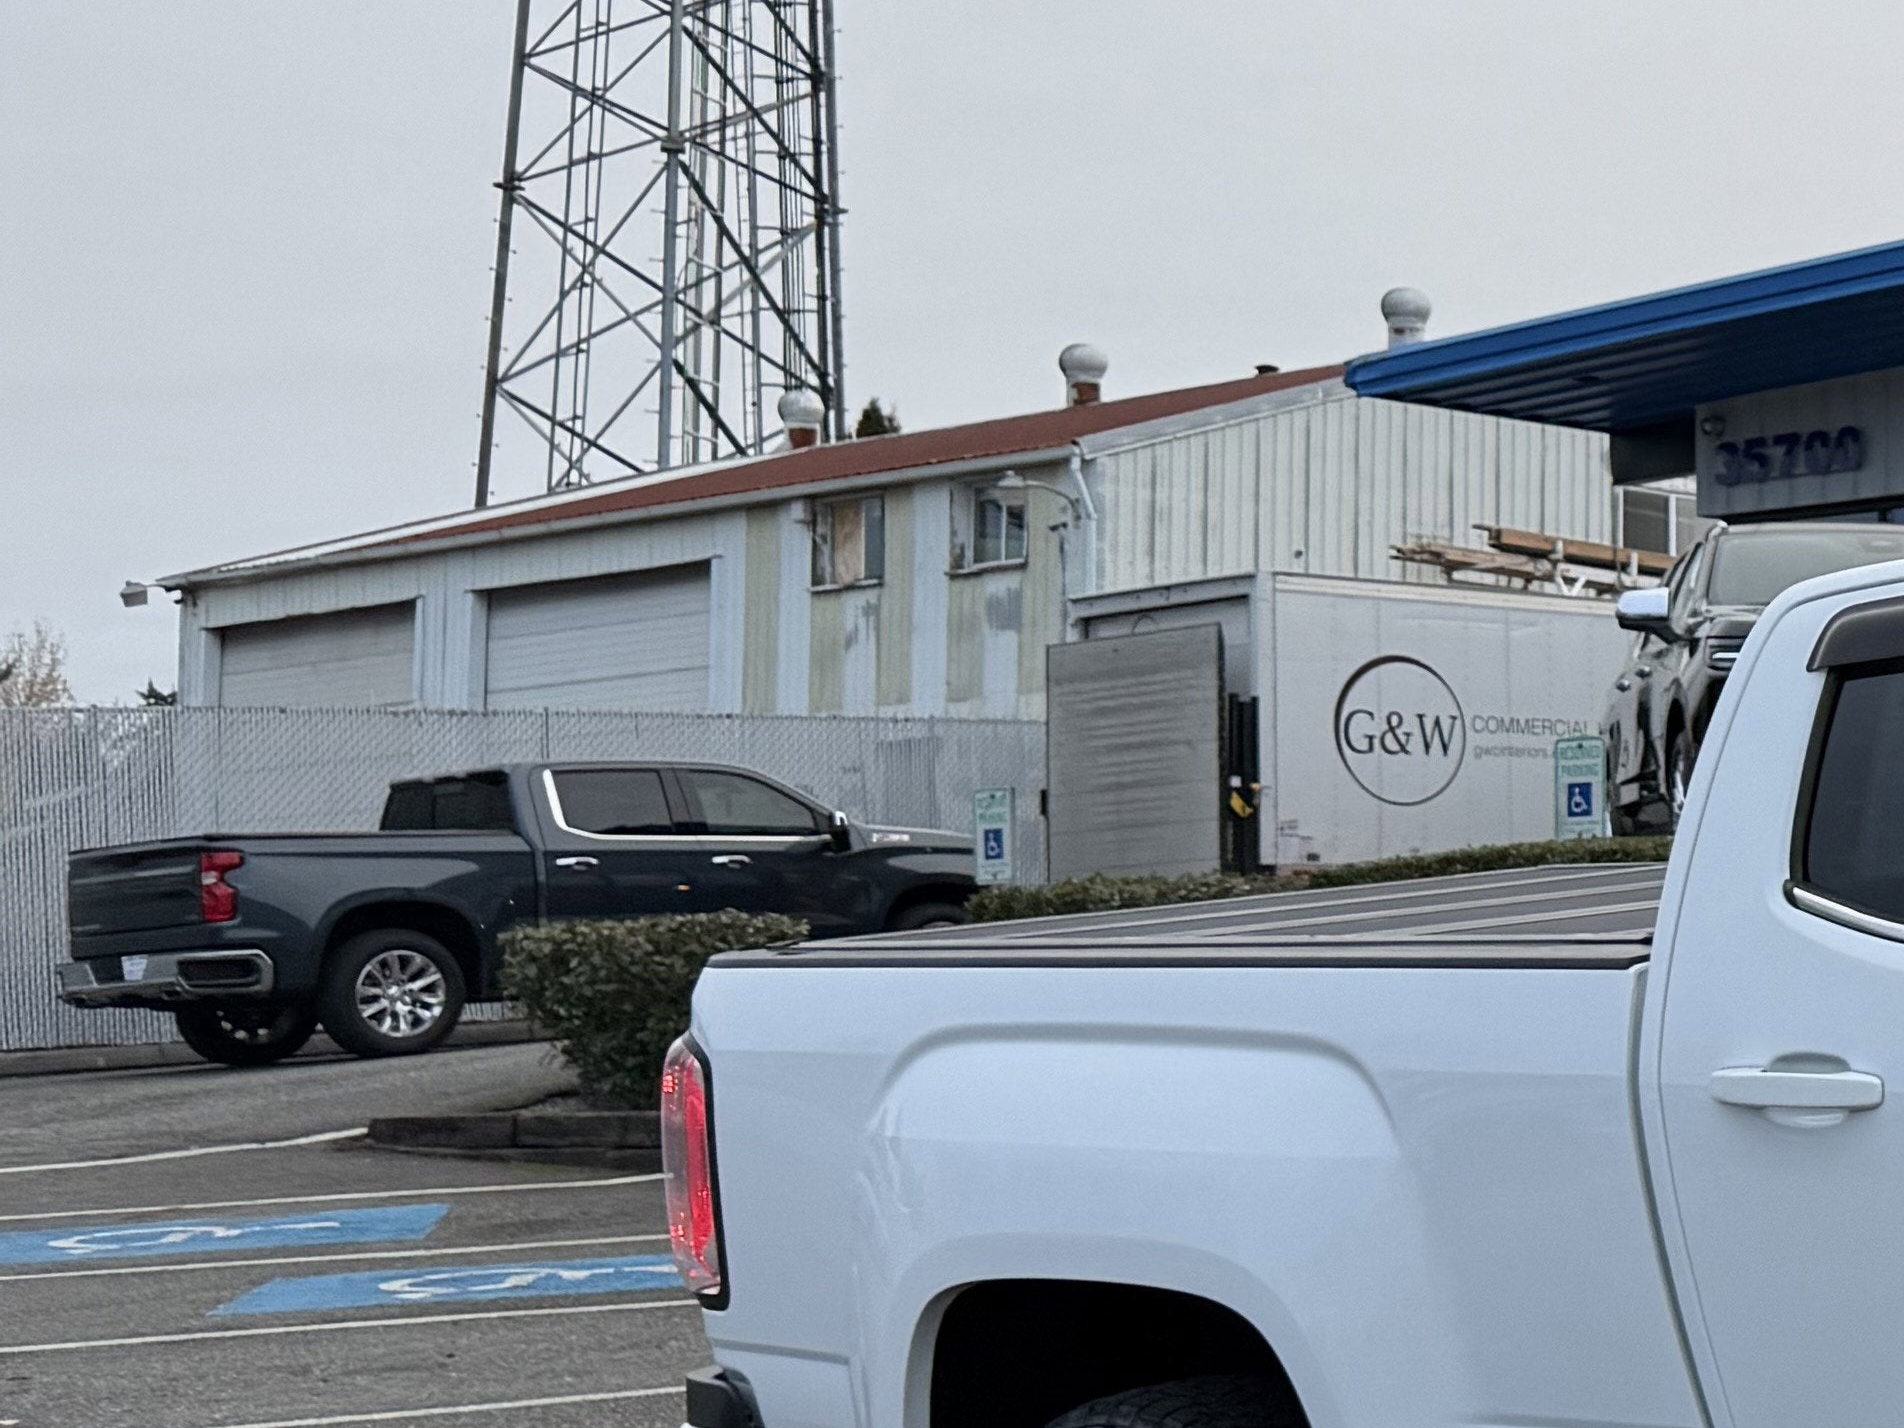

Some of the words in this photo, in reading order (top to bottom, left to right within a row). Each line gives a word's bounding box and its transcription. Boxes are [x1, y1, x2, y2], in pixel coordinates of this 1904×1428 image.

[1715, 426, 1866, 487] 35700
[1343, 708, 1458, 758] G&W
[1472, 714, 1588, 737] COMMERCIAL
